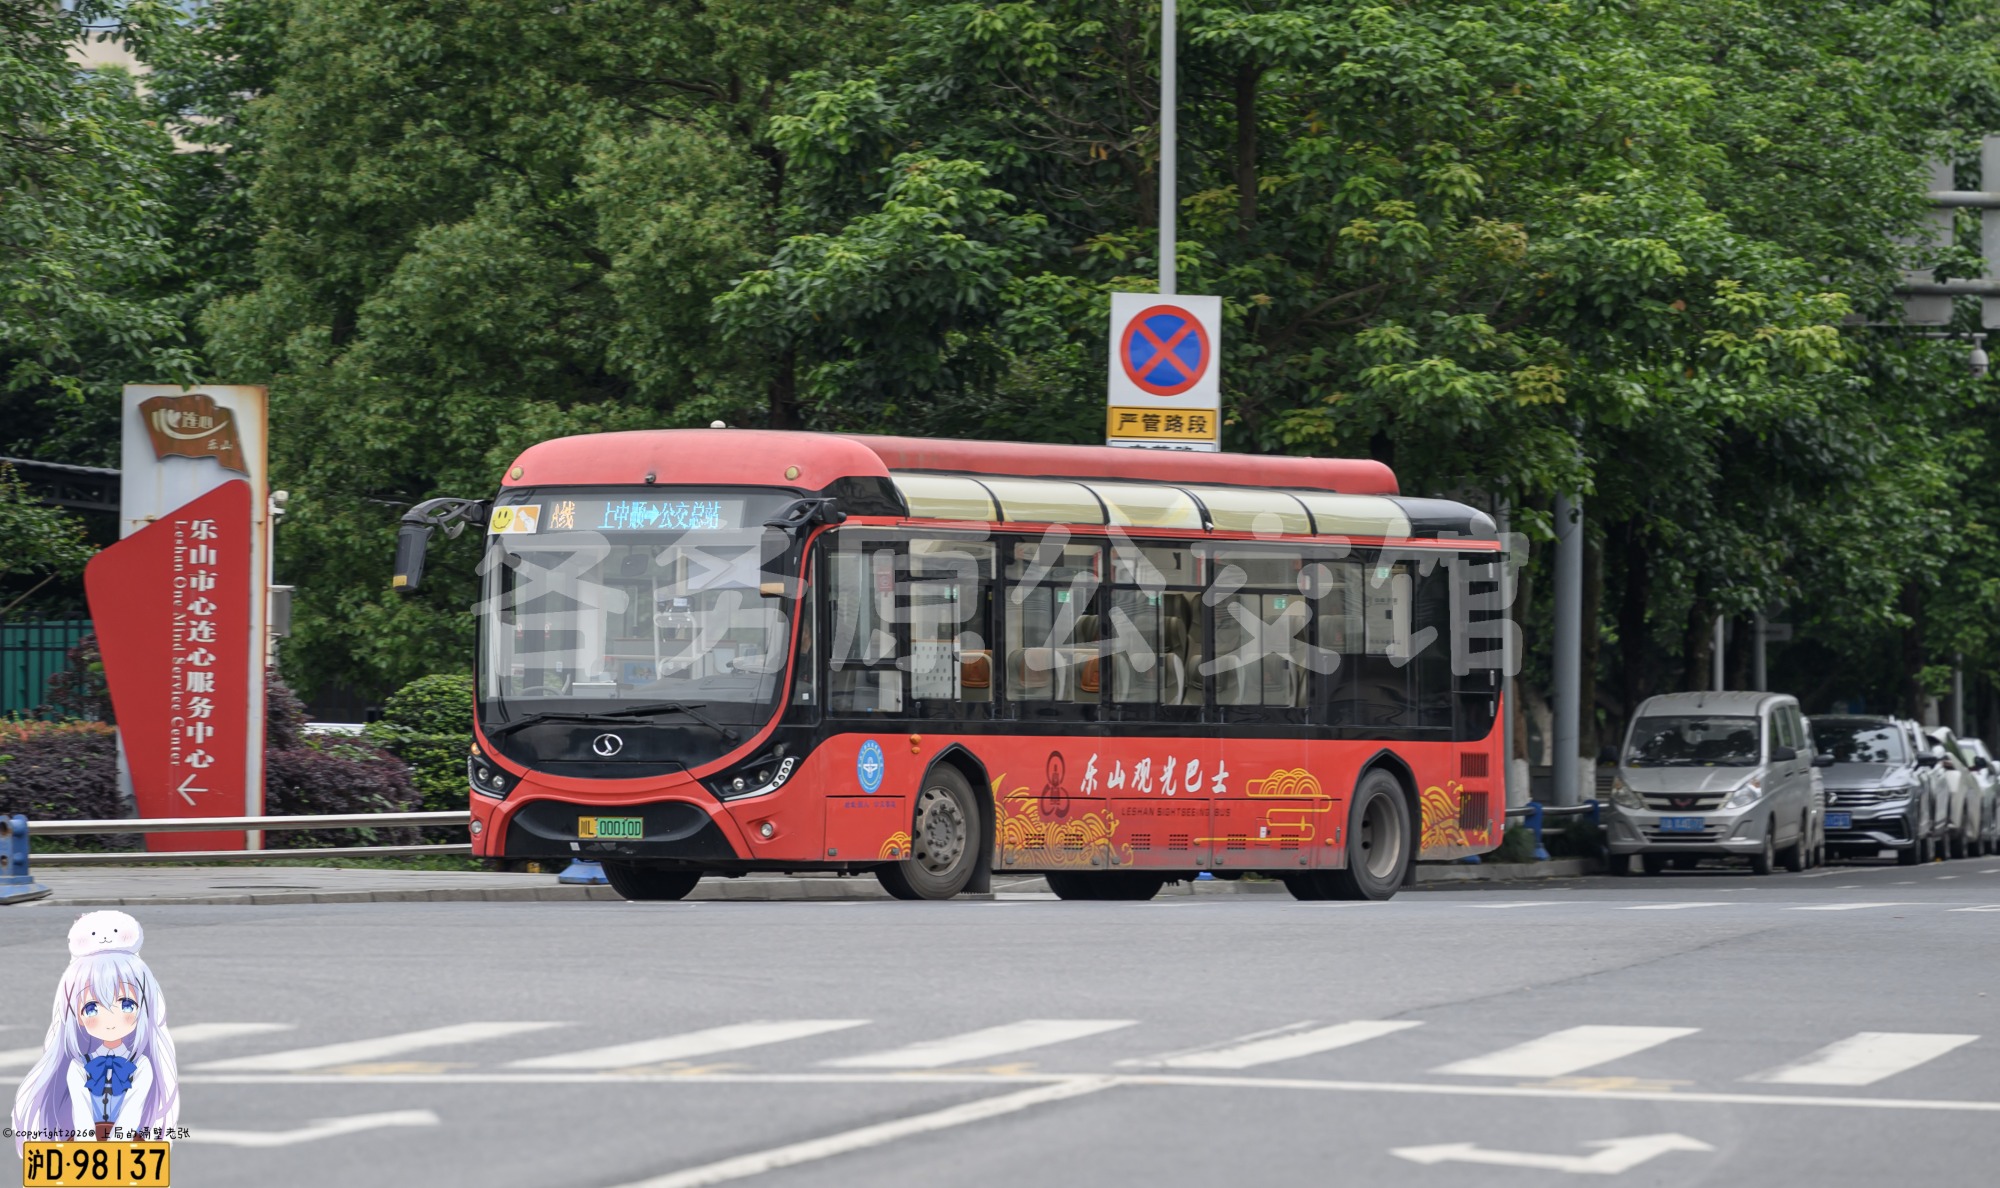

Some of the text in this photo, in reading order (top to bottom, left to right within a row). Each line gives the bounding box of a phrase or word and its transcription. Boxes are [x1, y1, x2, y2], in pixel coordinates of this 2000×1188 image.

[1118, 412, 1208, 434] 严管路段
[207, 438, 233, 451] 乐山
[658, 500, 722, 529] 公交总站
[170, 520, 188, 766] Leshan One Mind Service Center
[184, 519, 218, 768] 乐山市心连心服务中心
[1080, 752, 1230, 797] 乐山观光巴士
[1121, 807, 1232, 817] LESHAN SIGHTSEEING BUS
